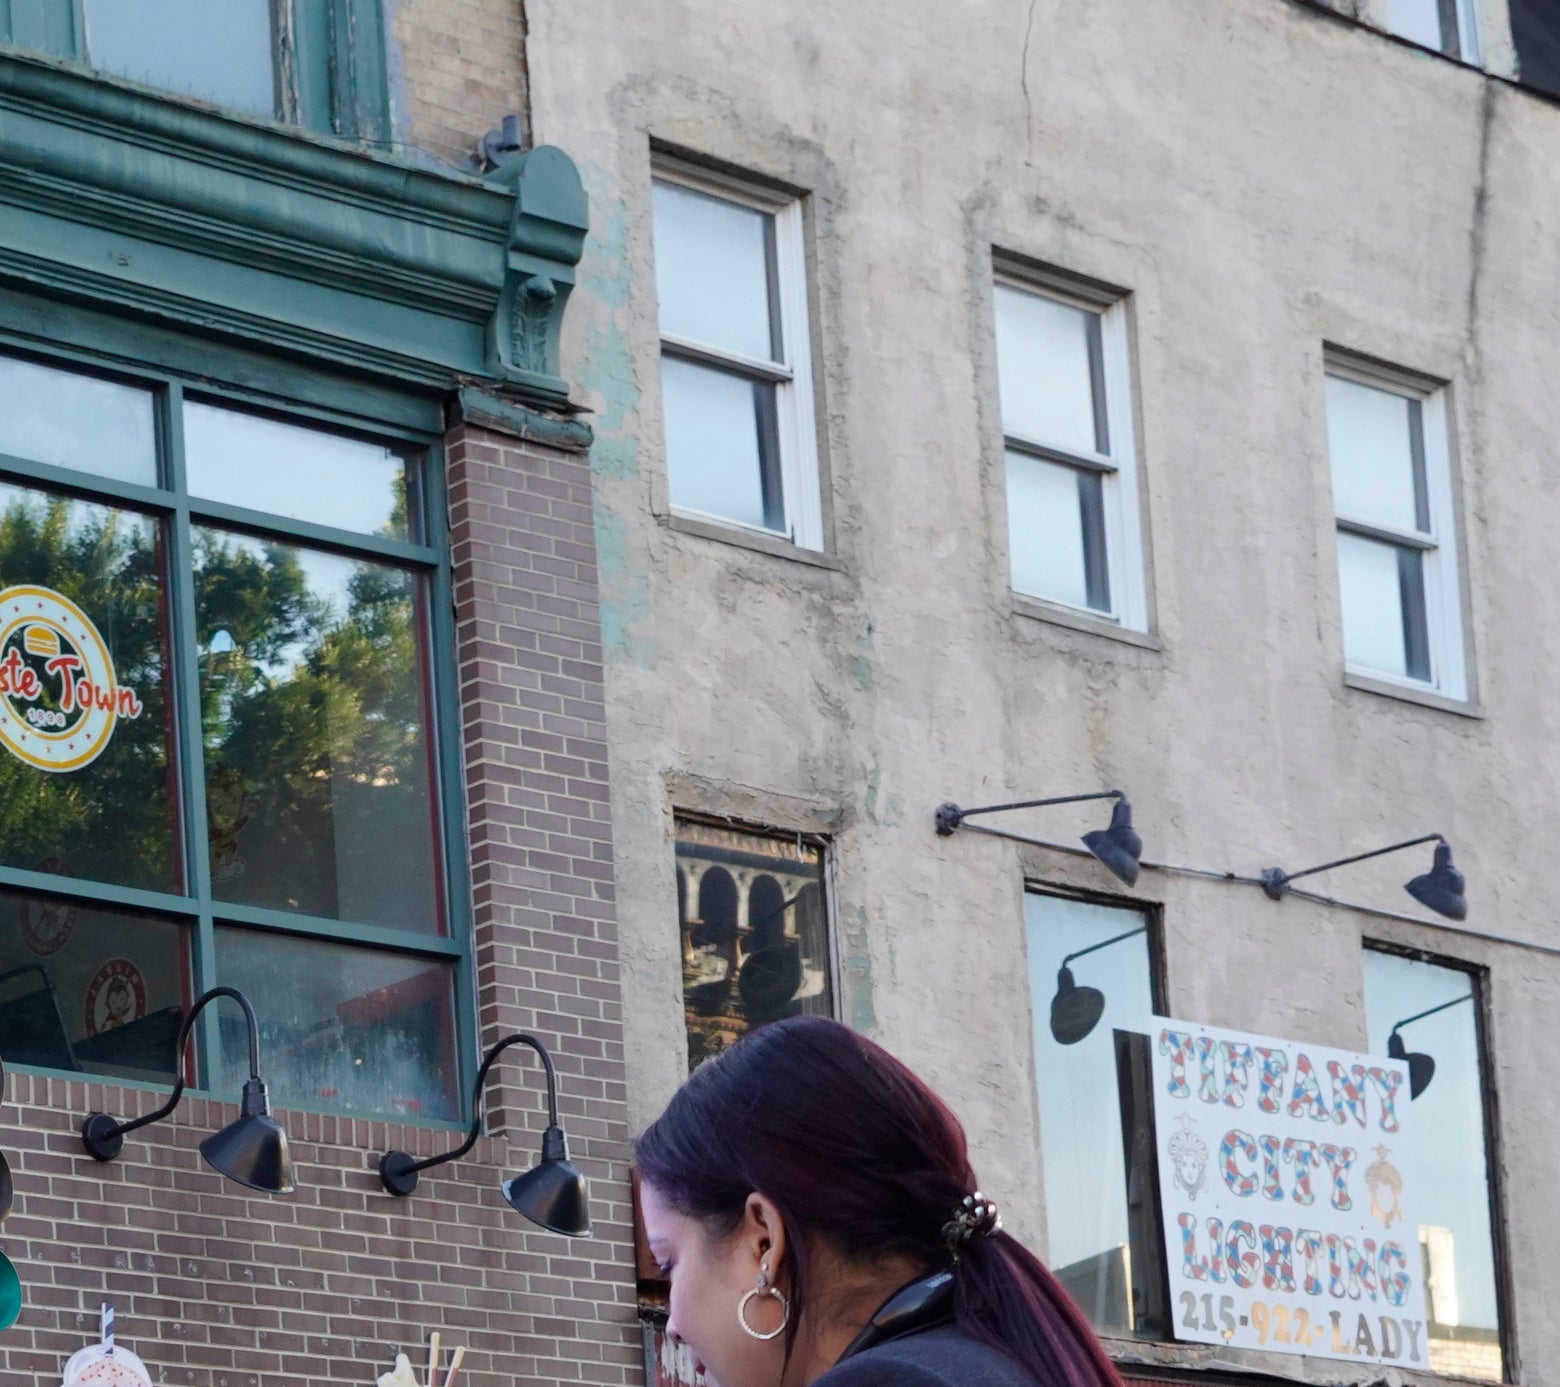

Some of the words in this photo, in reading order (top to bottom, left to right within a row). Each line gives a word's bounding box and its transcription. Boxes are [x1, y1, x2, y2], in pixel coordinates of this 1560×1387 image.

[28, 709, 66, 726] 1898
[47, 656, 140, 717] Town
[1158, 1028, 1403, 1134] TIFFANY
[1218, 1128, 1357, 1212] CITY
[1177, 1211, 1411, 1308] LIGHTING
[1179, 1289, 1423, 1363] 215-922-LADY
